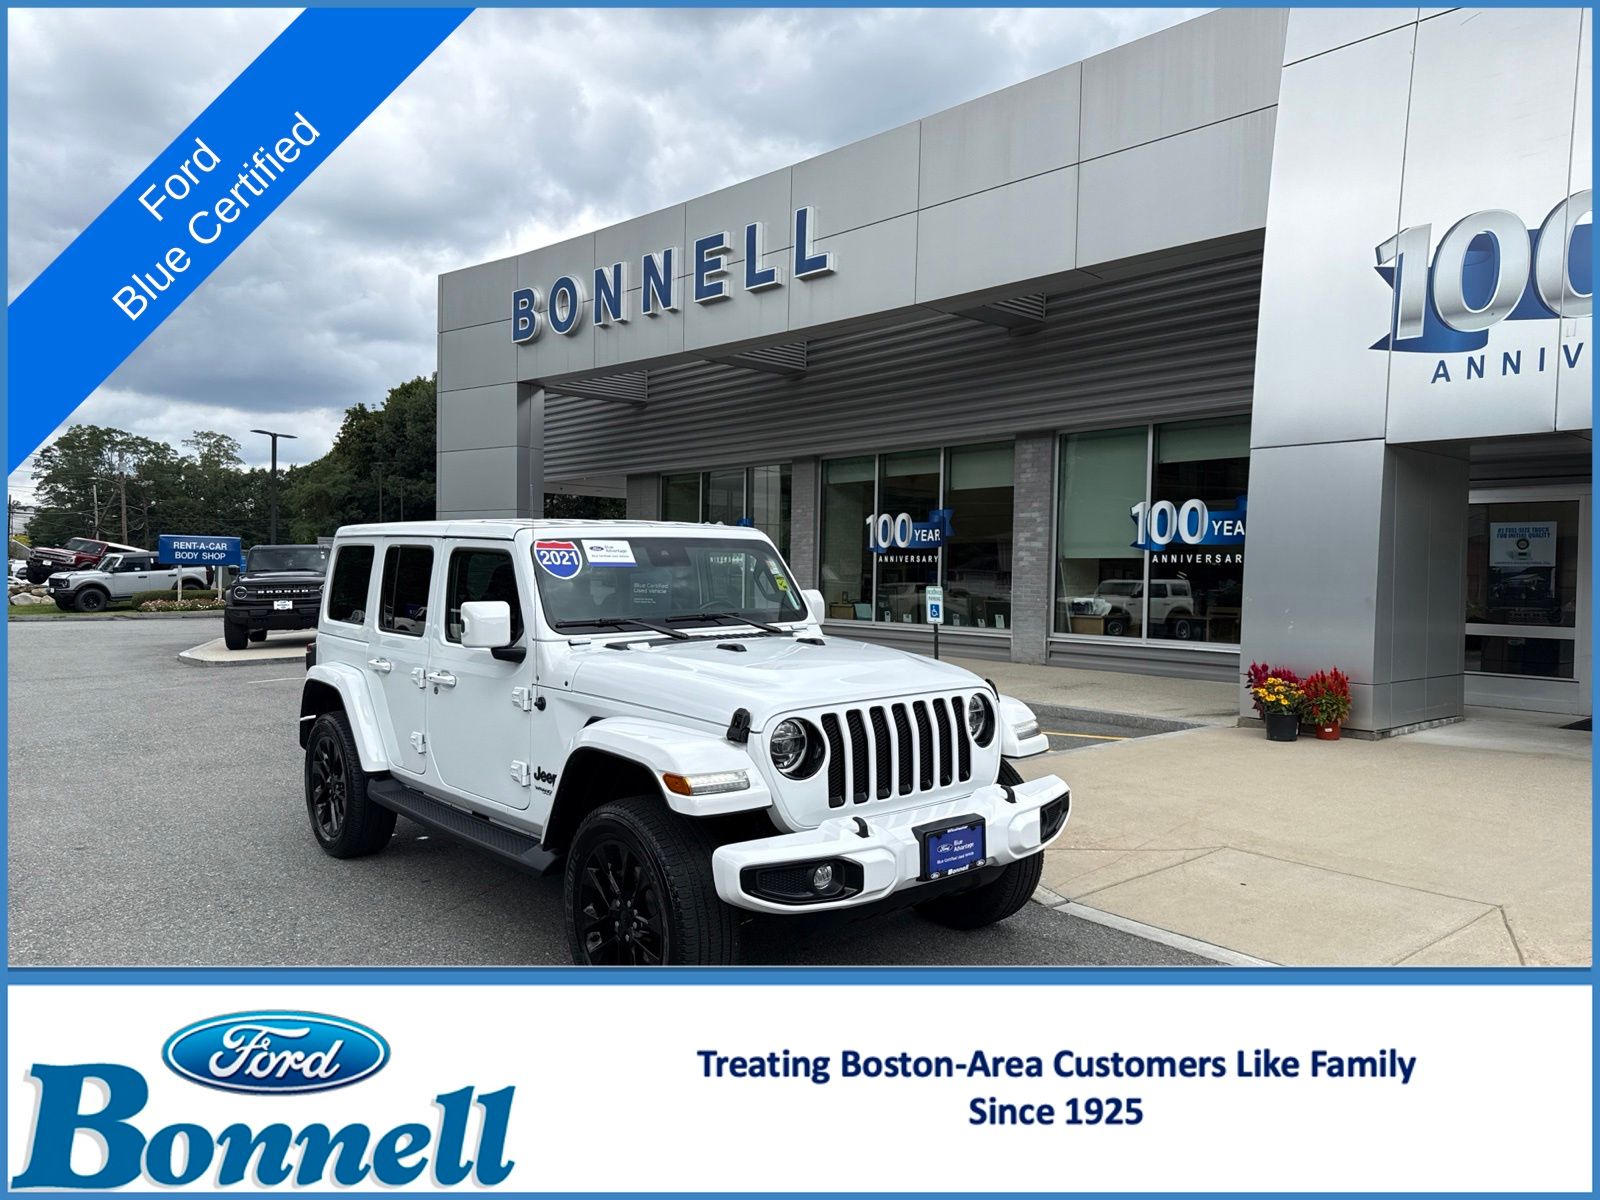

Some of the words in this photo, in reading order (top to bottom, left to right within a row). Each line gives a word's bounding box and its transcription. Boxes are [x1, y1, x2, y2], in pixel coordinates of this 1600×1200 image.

[511, 206, 835, 344] BONNELL
[865, 512, 913, 548] 100
[914, 528, 941, 542] YEAR
[1130, 498, 1209, 545] 100
[173, 541, 228, 551] RENT-A-CAR
[175, 552, 199, 560] BODY
[202, 552, 226, 560] SHOP
[540, 550, 579, 566] 2021
[878, 555, 939, 563] ANNIVERSARY
[534, 766, 557, 788] Jeep
